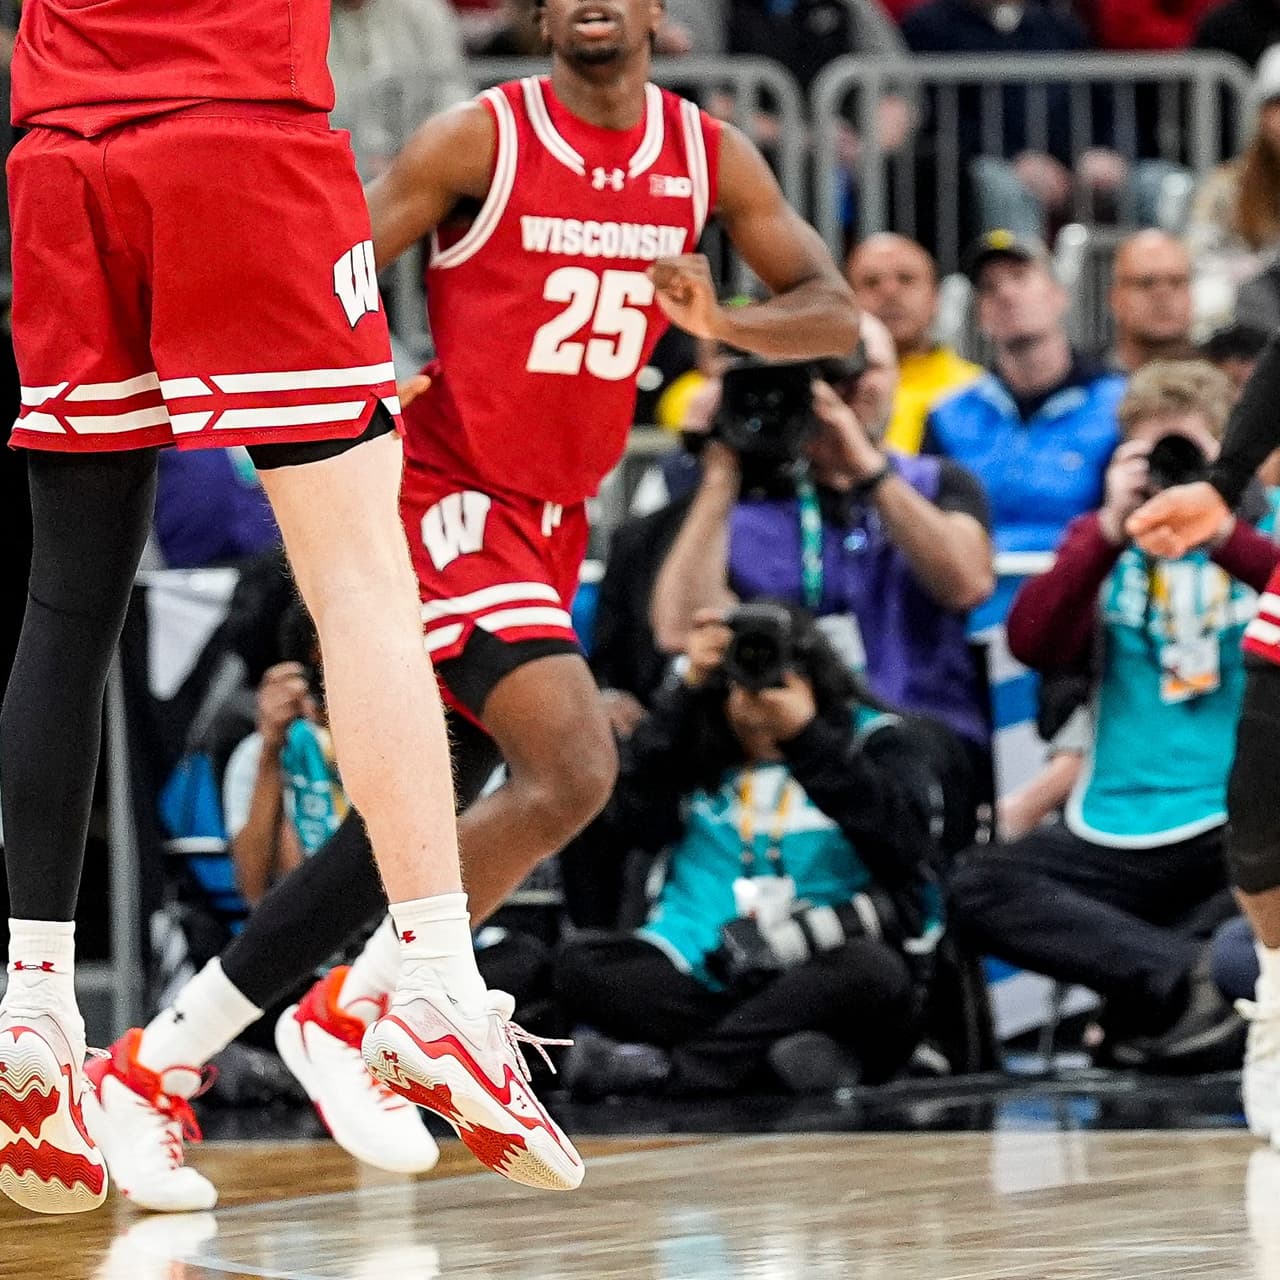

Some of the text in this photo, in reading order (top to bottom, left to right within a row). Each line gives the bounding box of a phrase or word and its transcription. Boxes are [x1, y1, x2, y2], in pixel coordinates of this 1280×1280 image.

[520, 214, 689, 261] WISCONSIN
[332, 239, 380, 331] W
[525, 265, 657, 382] 25
[420, 490, 492, 572] W
